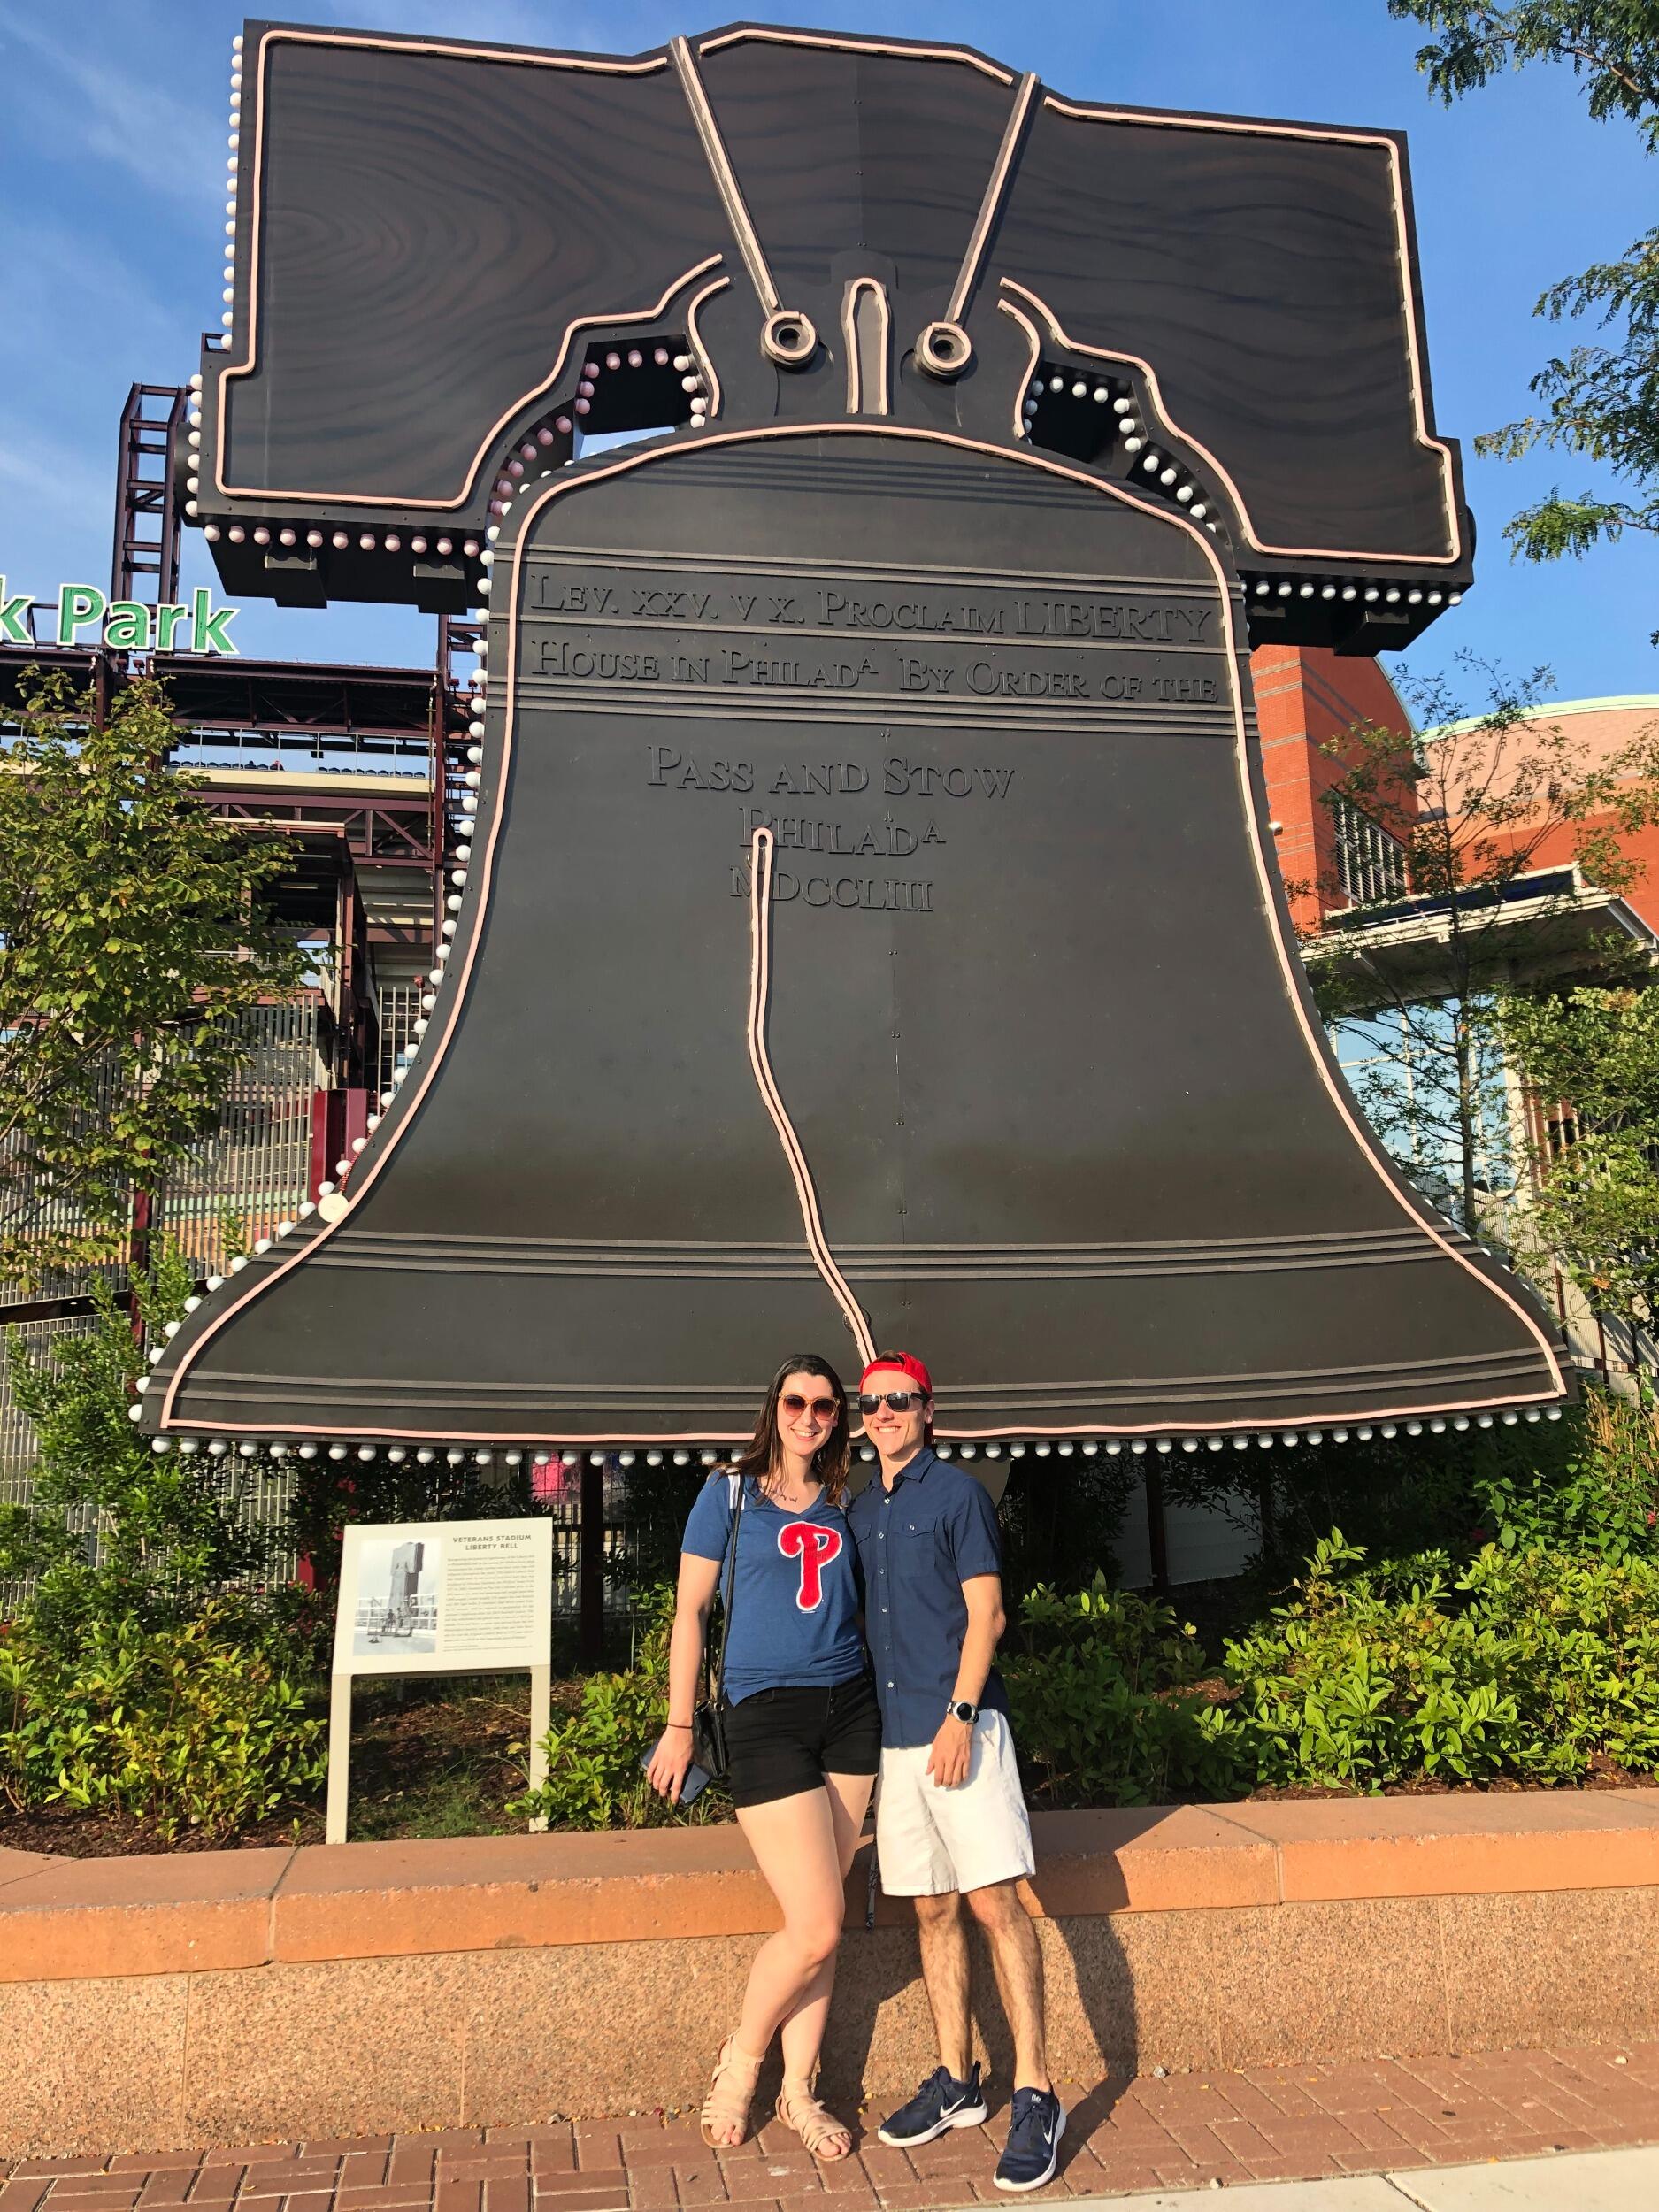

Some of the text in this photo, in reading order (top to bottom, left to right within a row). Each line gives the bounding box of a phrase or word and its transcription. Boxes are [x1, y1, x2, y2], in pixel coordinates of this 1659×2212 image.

[56, 583, 240, 655] Park
[1014, 601, 1212, 642] LIBERTY
[647, 744, 1017, 798] PASS AND STOW
[778, 1521, 842, 1610] P
